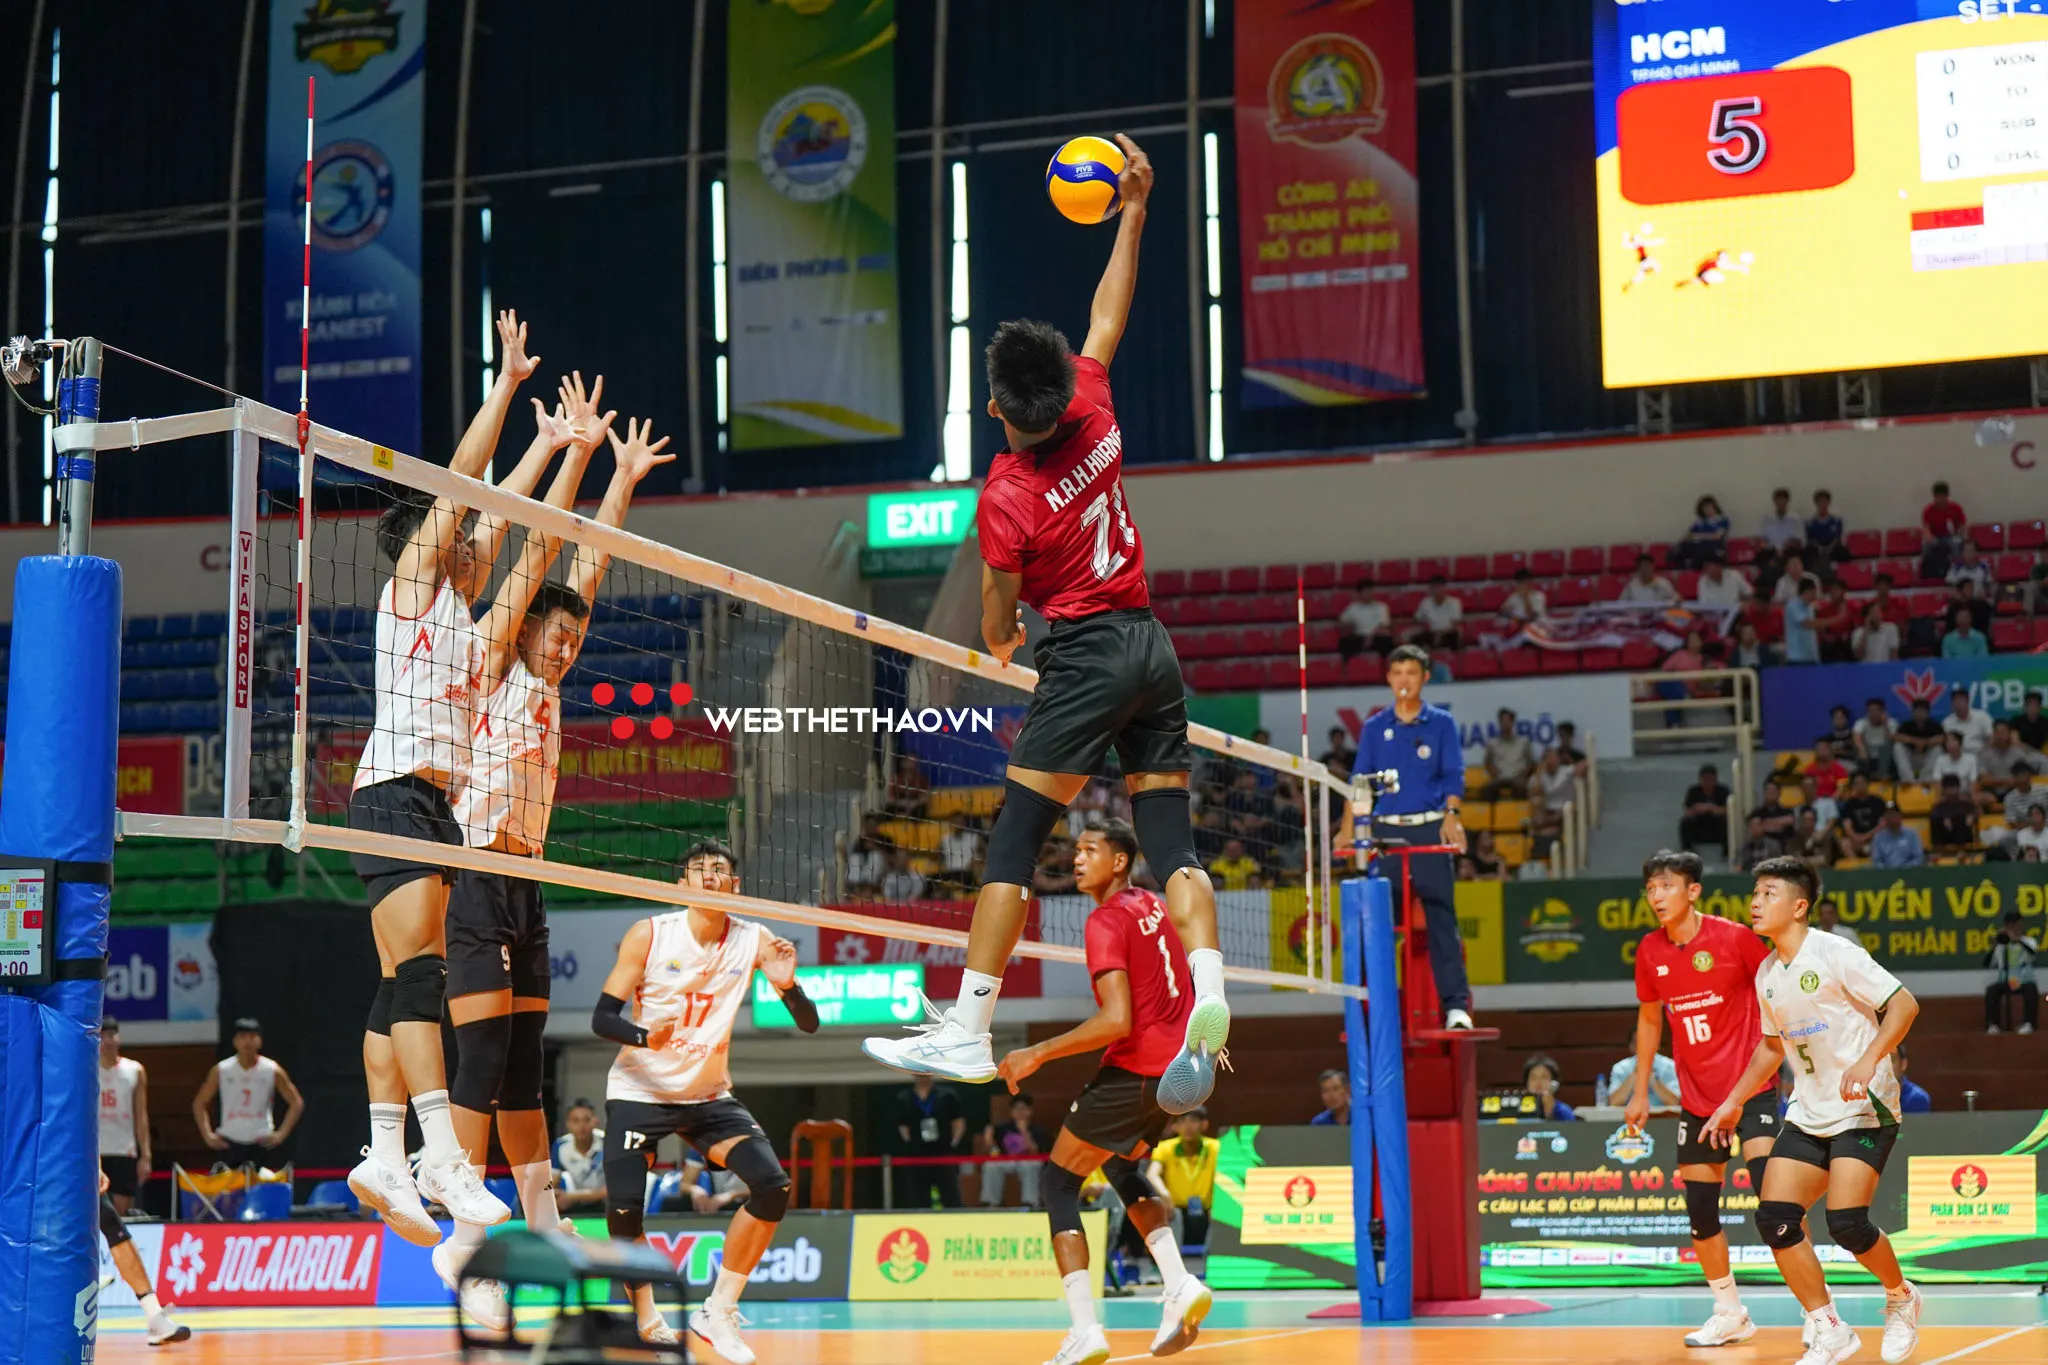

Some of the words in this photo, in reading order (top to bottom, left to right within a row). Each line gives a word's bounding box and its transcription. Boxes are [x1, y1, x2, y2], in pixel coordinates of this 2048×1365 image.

[1630, 26, 1726, 63] HCM
[1943, 57, 1956, 75] 0
[1993, 53, 2037, 67] WON
[1948, 91, 1955, 106] 1
[1706, 95, 1768, 176] 5
[1946, 121, 1959, 139] 0
[1947, 152, 1960, 171] 0
[886, 500, 959, 539] EXIT
[236, 536, 252, 705] VIFASPORT
[500, 943, 511, 971] 9
[1156, 934, 1180, 998] 1
[105, 952, 158, 1001] ab
[682, 991, 715, 1028] 17
[891, 969, 920, 1021] 5
[1682, 1013, 1712, 1046] 16
[1796, 1043, 1815, 1075] 5
[623, 1130, 647, 1150] 17
[1626, 1167, 1664, 1191] VÔ
[207, 1233, 375, 1293] JOGARBOLA
[943, 1233, 984, 1262] PHÂN
